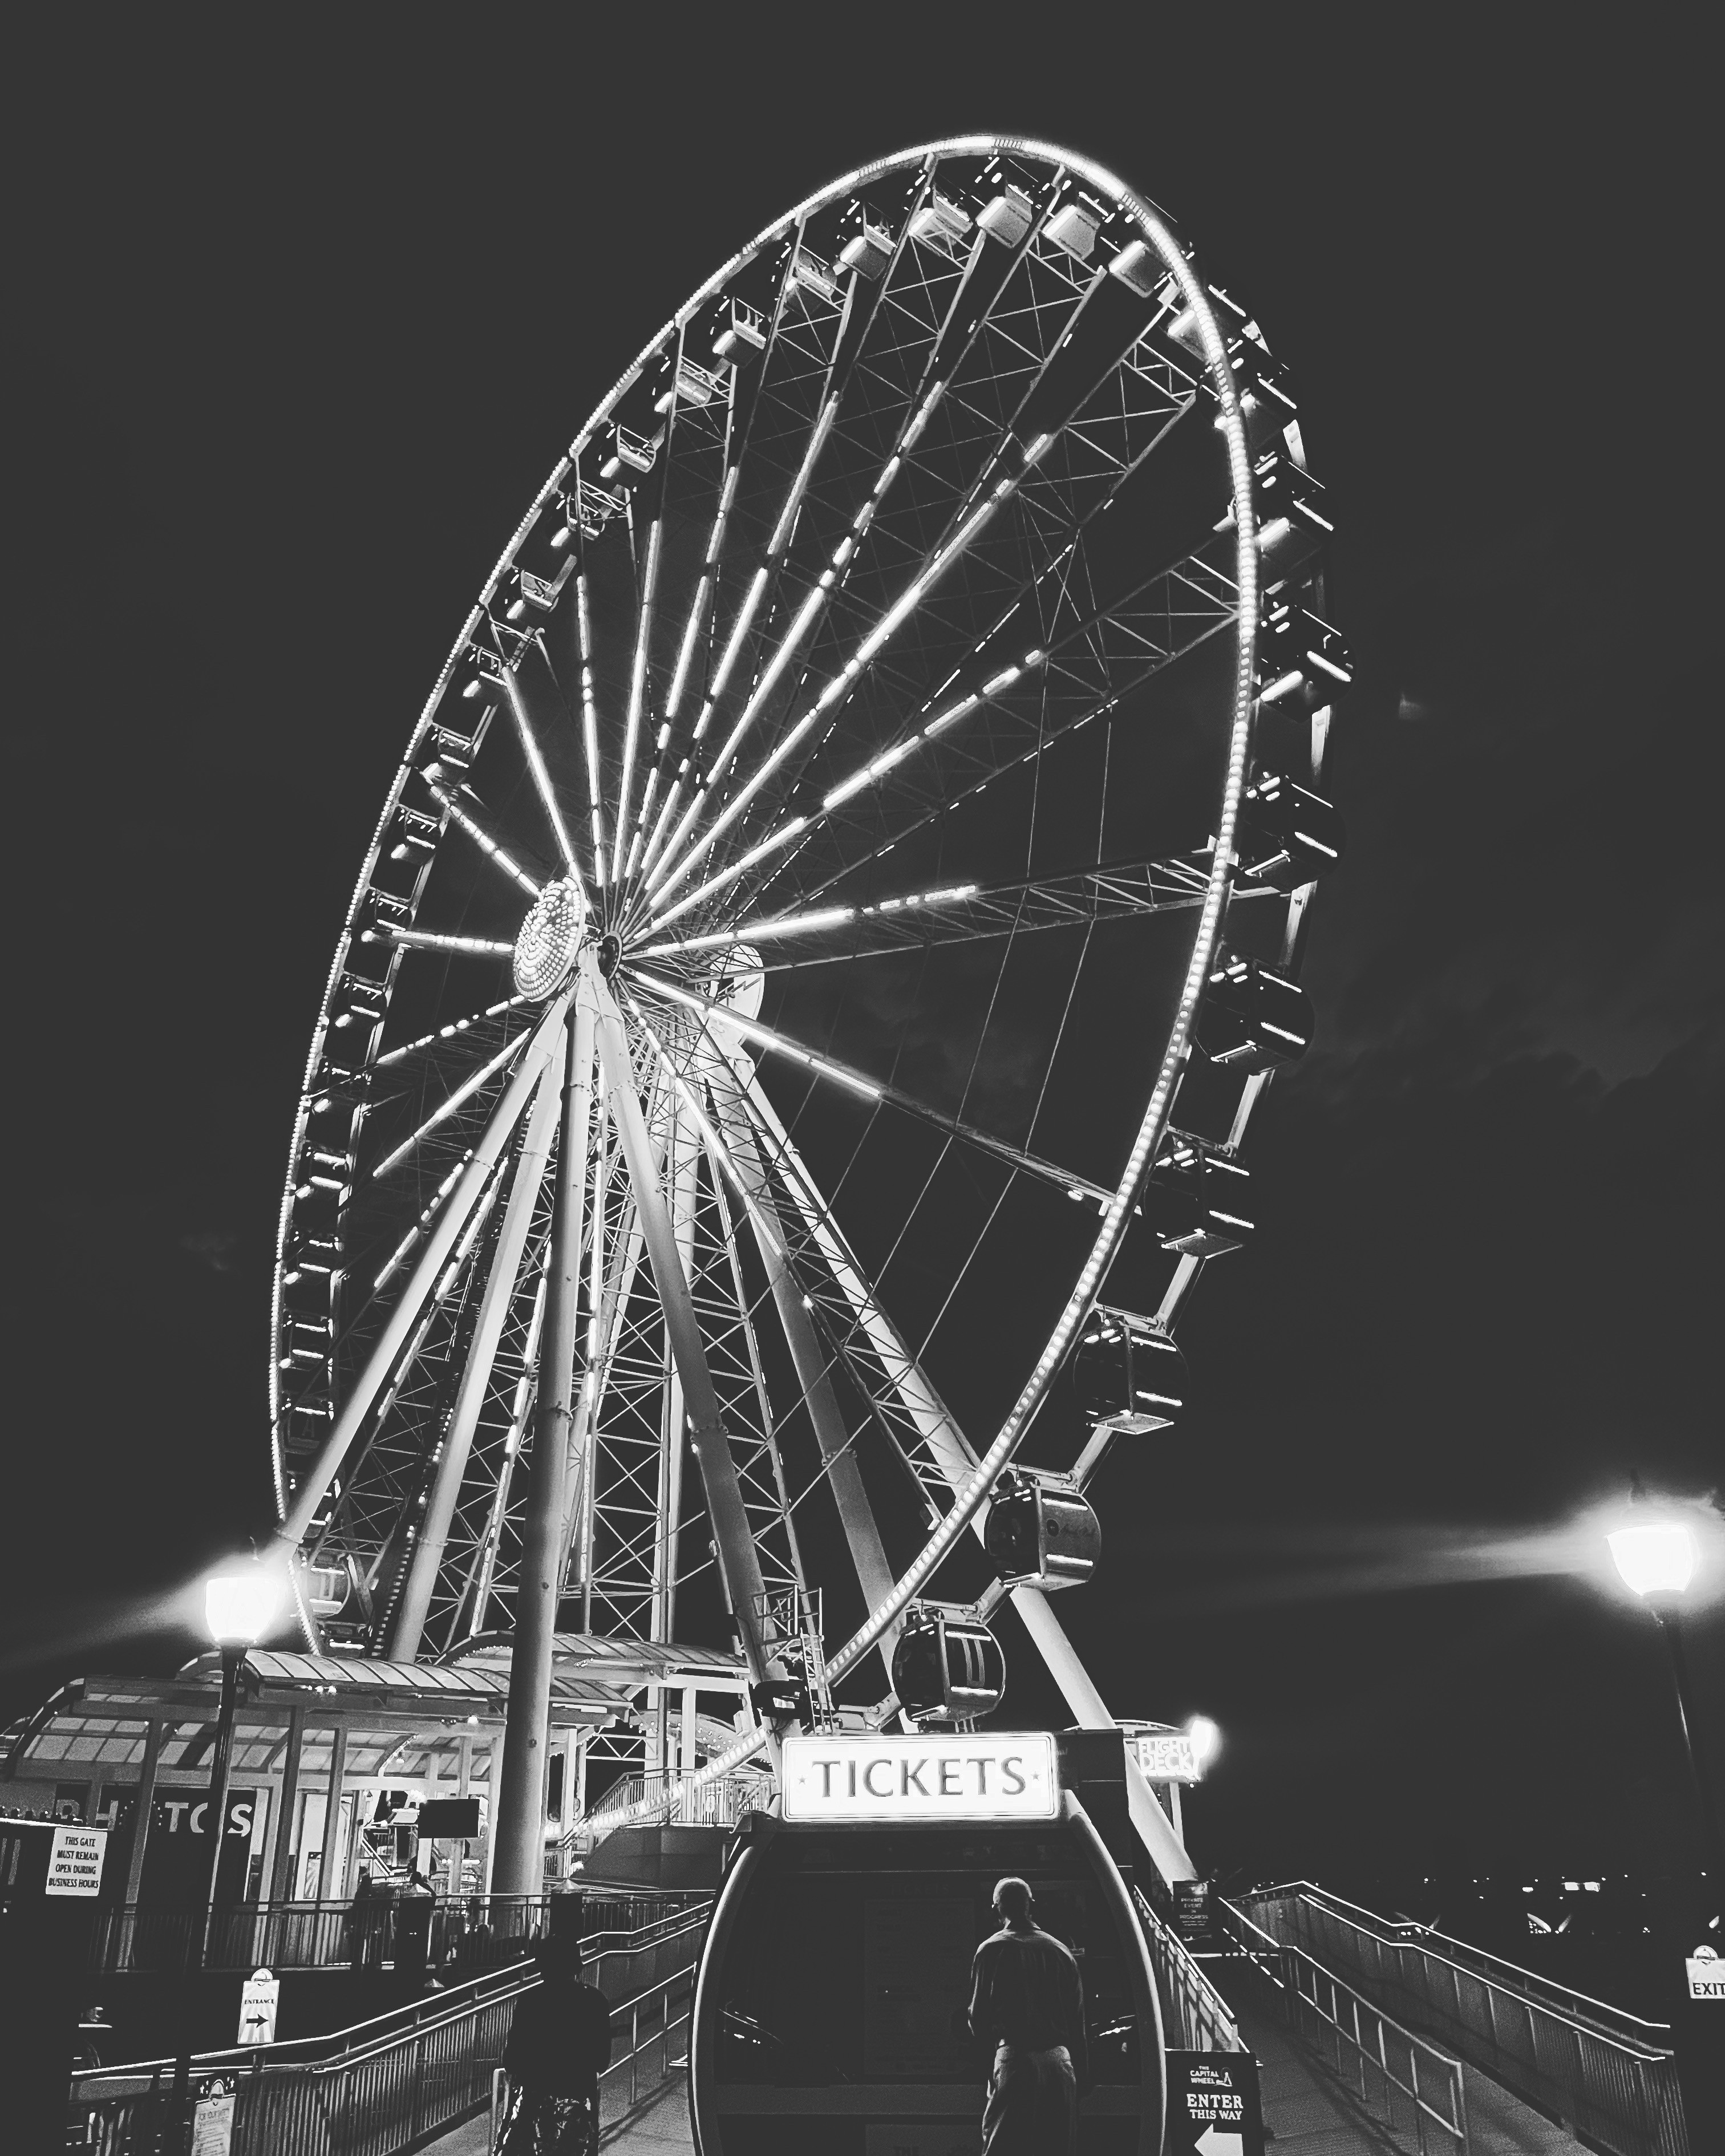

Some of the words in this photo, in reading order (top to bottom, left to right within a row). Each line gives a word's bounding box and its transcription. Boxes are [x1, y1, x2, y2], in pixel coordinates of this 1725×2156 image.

[1140, 1740, 1191, 1754] FLIGHT
[1140, 1752, 1193, 1770] DECK
[812, 1757, 1026, 1797] TICKETS
[65, 1836, 79, 1845] THIS
[80, 1838, 96, 1847] GATE
[57, 1850, 75, 1859] MUST
[75, 1851, 99, 1860] REMAIN
[55, 1863, 71, 1873] OPEN
[73, 1865, 96, 1874] DURING
[48, 1878, 77, 1887] BUSINESS
[78, 1879, 99, 1888] HOURS
[1692, 1983, 1725, 1995] EXIT
[1187, 2094, 1244, 2109] ENTER
[1189, 2109, 1217, 2119] THIS
[1218, 2110, 1242, 2120] WAY
